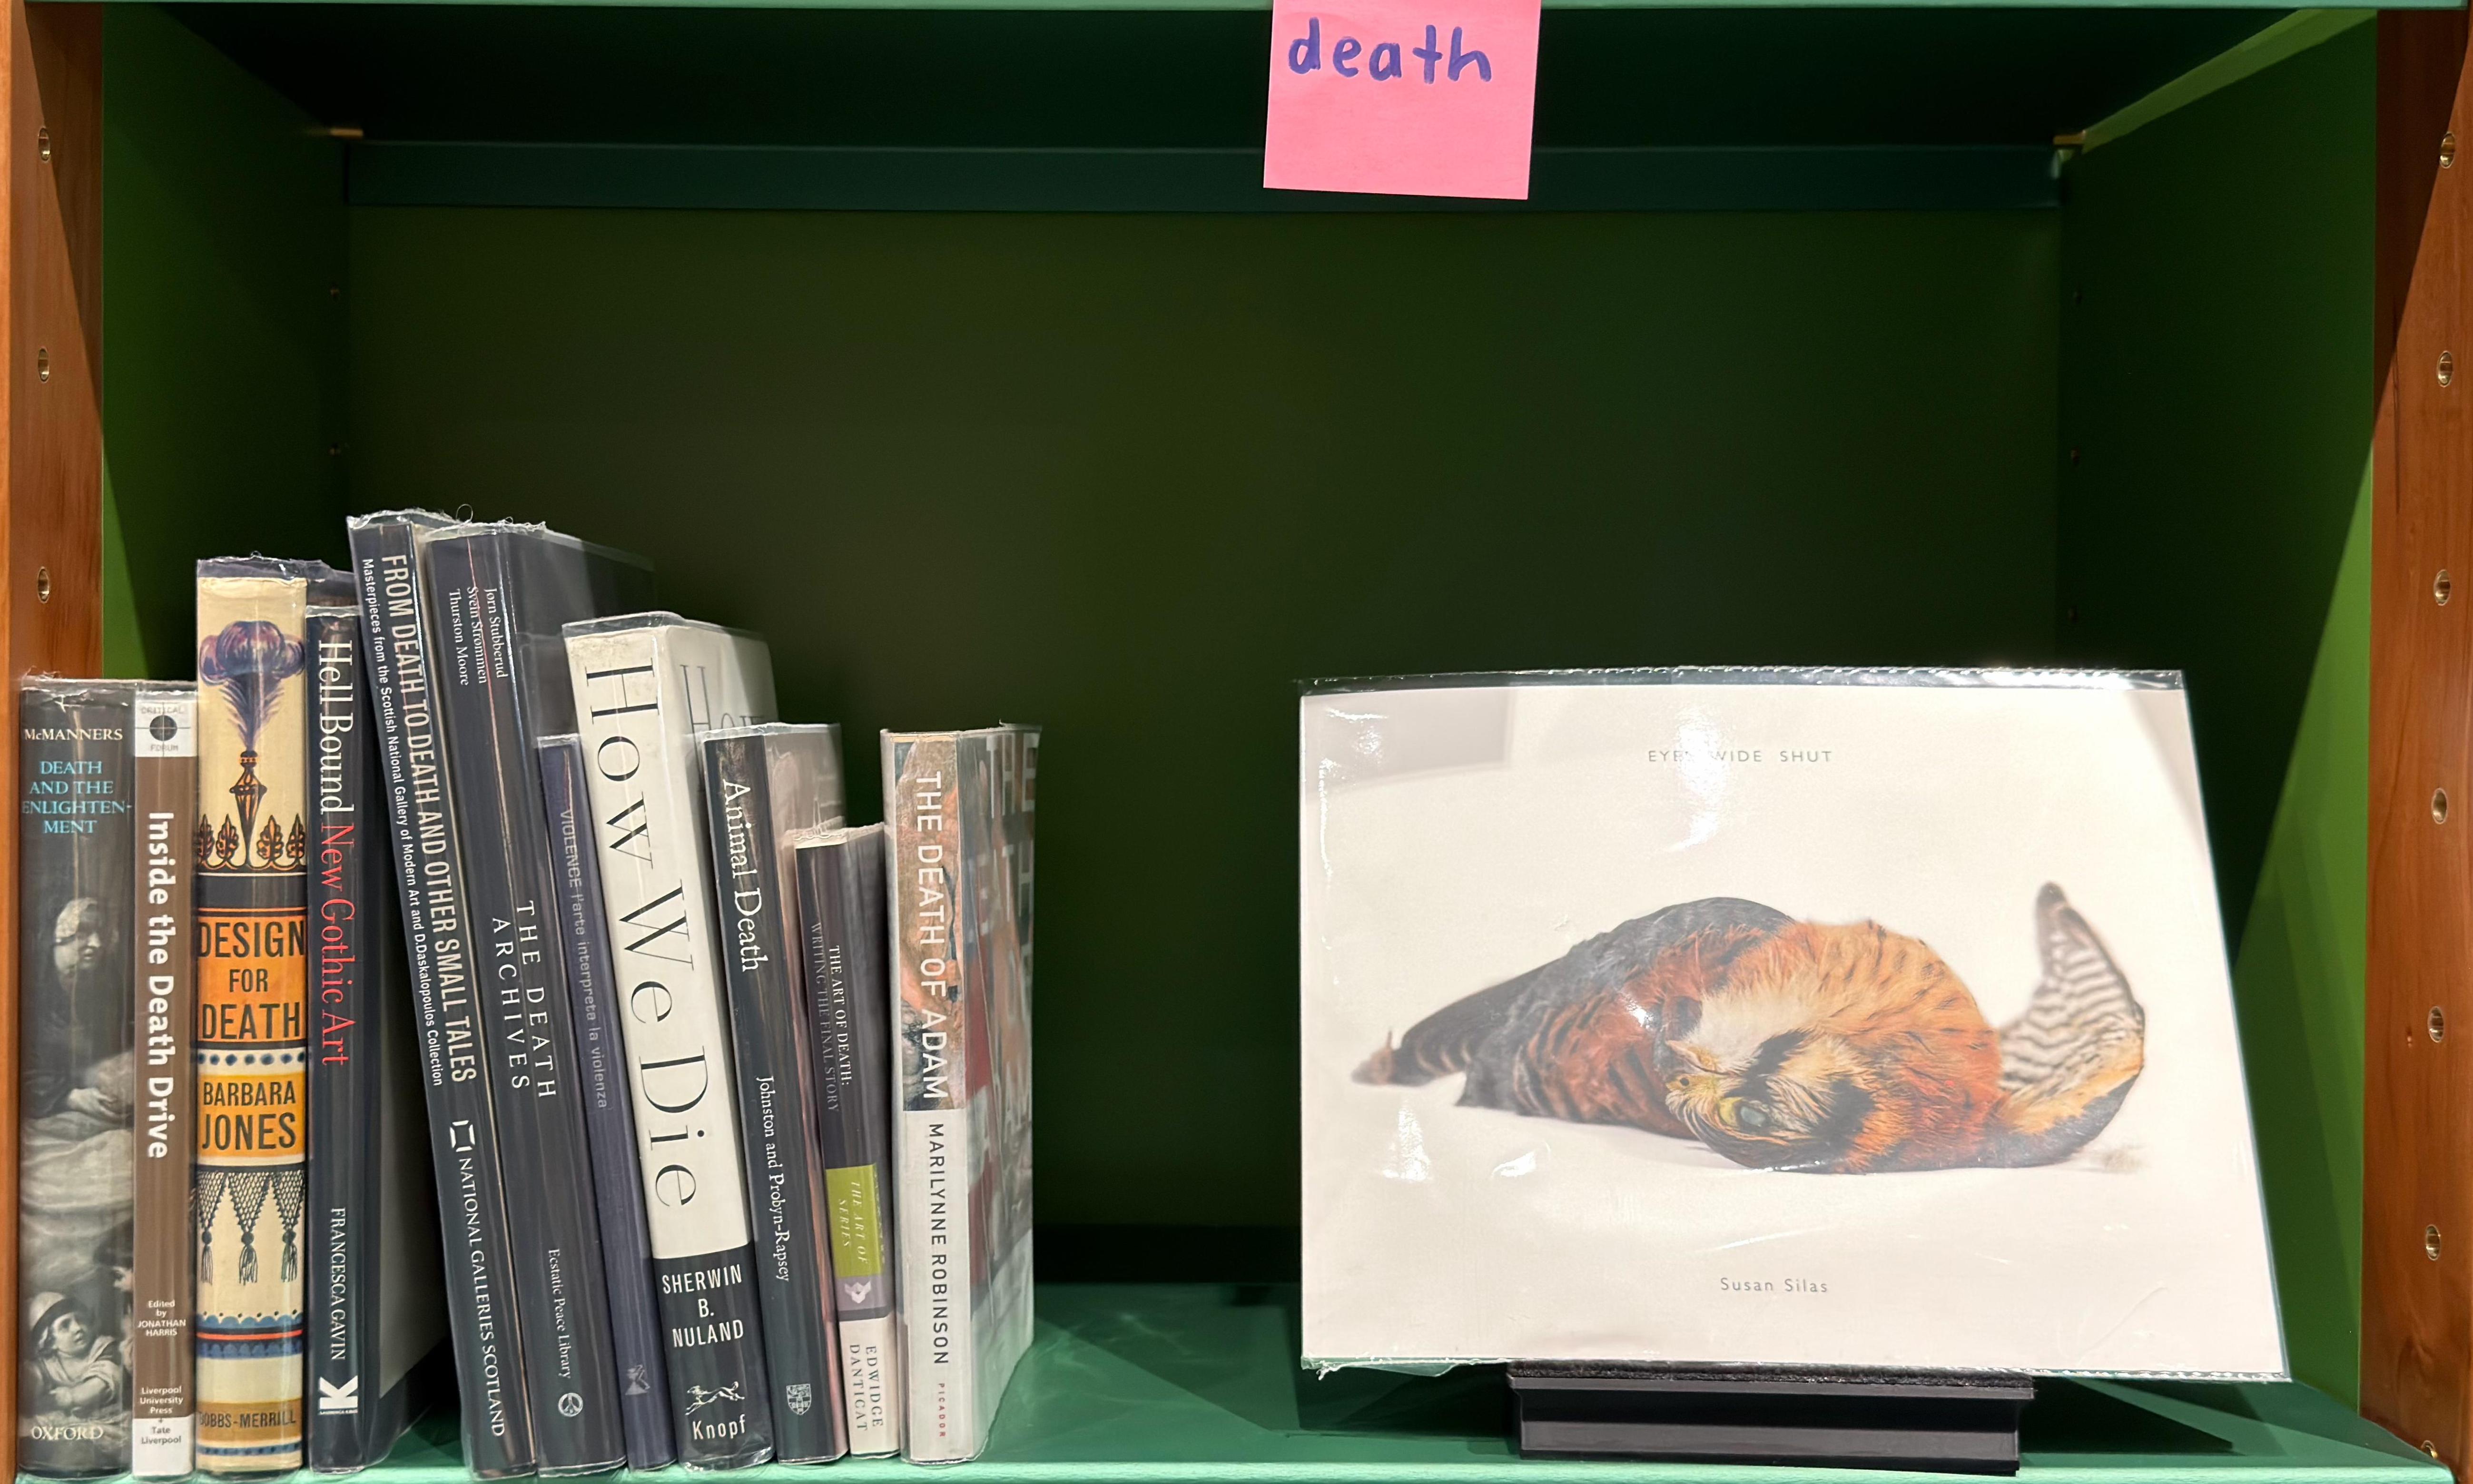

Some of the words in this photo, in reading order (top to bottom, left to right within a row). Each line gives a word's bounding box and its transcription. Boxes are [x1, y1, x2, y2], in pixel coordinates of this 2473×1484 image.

[1288, 17, 1492, 84] death
[362, 558, 381, 634] Masterpieces
[382, 554, 414, 617] FROM
[467, 586, 481, 619] Svein
[449, 587, 464, 643] Thurston
[373, 636, 385, 662] from
[392, 624, 425, 694] DEATH
[455, 646, 469, 686] Moore
[489, 616, 508, 678] Stubberud
[319, 639, 353, 706] Hell
[377, 665, 390, 684] the
[140, 706, 184, 714] CRITICAL
[381, 687, 398, 733] Scottish
[403, 698, 430, 727] TO
[25, 728, 123, 740] McMANNERS
[150, 744, 179, 752] FORUM
[1648, 750, 1691, 762] EYE
[1780, 750, 1832, 762] SHUT
[39, 761, 102, 775] DEATH
[319, 712, 355, 816] Bound
[387, 736, 405, 784] National
[407, 734, 441, 804] DEATH
[585, 657, 660, 870] How
[986, 732, 1041, 819] THE
[22, 800, 132, 815] ENLIGHTEN-
[29, 781, 69, 795] AND
[73, 781, 114, 795] THE
[394, 786, 409, 826] Gallery
[916, 771, 942, 832] THE
[43, 820, 98, 834] MENT
[400, 829, 413, 840] of
[417, 812, 447, 855] AND
[560, 810, 582, 889] VIOLENCE
[723, 778, 758, 880] Animal
[148, 812, 176, 905] Inside
[320, 823, 355, 892] New
[403, 844, 416, 886] Modern
[408, 889, 421, 906] Art
[424, 861, 457, 933] OTHER
[917, 845, 945, 945] DEATH
[148, 914, 176, 965] the
[198, 920, 305, 958] DESIGN
[411, 909, 424, 930] and
[516, 899, 541, 965] THE
[734, 888, 769, 973] Death
[320, 898, 355, 1004] Gothic
[619, 879, 694, 1024] We
[810, 922, 827, 985] WRITING
[829, 944, 842, 975] THE
[229, 968, 269, 993] FOR
[414, 934, 436, 1027] D.Daskalopoulos
[434, 939, 467, 1012] SMALL
[577, 941, 597, 1021] interpreta
[832, 978, 845, 1005] ART
[920, 957, 946, 997] OF
[148, 976, 176, 1066] Death
[202, 1002, 301, 1041] DEATH
[492, 917, 531, 1090] ARCHIVES
[817, 987, 830, 1018] THE
[834, 1009, 847, 1028] OF
[320, 1009, 356, 1066] Art
[445, 1015, 477, 1082] TALES
[526, 986, 557, 1098] DEATH
[588, 1027, 599, 1042] la
[820, 1021, 834, 1063] FINAL
[920, 1009, 948, 1099] ADAM
[427, 1030, 443, 1086] Collection
[592, 1047, 607, 1109] violenza
[837, 1032, 852, 1086] DEATH:
[203, 1081, 296, 1107] BARBARA
[756, 1076, 777, 1138] Johnston
[824, 1066, 839, 1112] STORY
[148, 1077, 176, 1158] Drive
[202, 1113, 296, 1150] JONES
[638, 1045, 709, 1207] Die
[765, 1142, 783, 1169] and
[851, 1181, 862, 1208] THE
[928, 1123, 946, 1245] MARILYNNE
[769, 1173, 790, 1283] Probyn-Rapsey
[838, 1198, 851, 1247] SERIES
[853, 1211, 865, 1240] ART
[331, 1207, 346, 1306] FRANCESCA
[548, 1248, 563, 1295] Ecstatic
[857, 1245, 868, 1264] OF
[459, 1158, 483, 1247] NATIONAL
[472, 1250, 494, 1342] GALLERIES
[483, 1345, 505, 1437] SCOTLAND
[661, 1264, 742, 1295] SHERWIN
[1720, 1277, 1773, 1291] Susan
[1784, 1278, 1828, 1292] Silas
[138, 1319, 187, 1328] JONATHAN
[148, 1299, 176, 1308] Edited
[156, 1308, 167, 1318] by
[554, 1298, 566, 1332] Peace
[698, 1298, 714, 1318] B.
[931, 1254, 949, 1364] ROBINSON
[145, 1328, 178, 1337] HARRIS
[331, 1308, 346, 1360] GAVIN
[672, 1319, 744, 1348] NULAND
[558, 1334, 571, 1379] Library
[139, 1396, 184, 1405] University
[141, 1385, 182, 1396] Liverpool
[849, 1344, 867, 1432] DANTICAT
[865, 1345, 883, 1427] EDWIDGE
[31, 1425, 103, 1441] OXFORD
[149, 1406, 173, 1415] Press
[151, 1425, 171, 1434] Tate
[692, 1414, 747, 1440] Knopf
[938, 1383, 946, 1437] PICADOR
[141, 1435, 182, 1445] Liverpool
